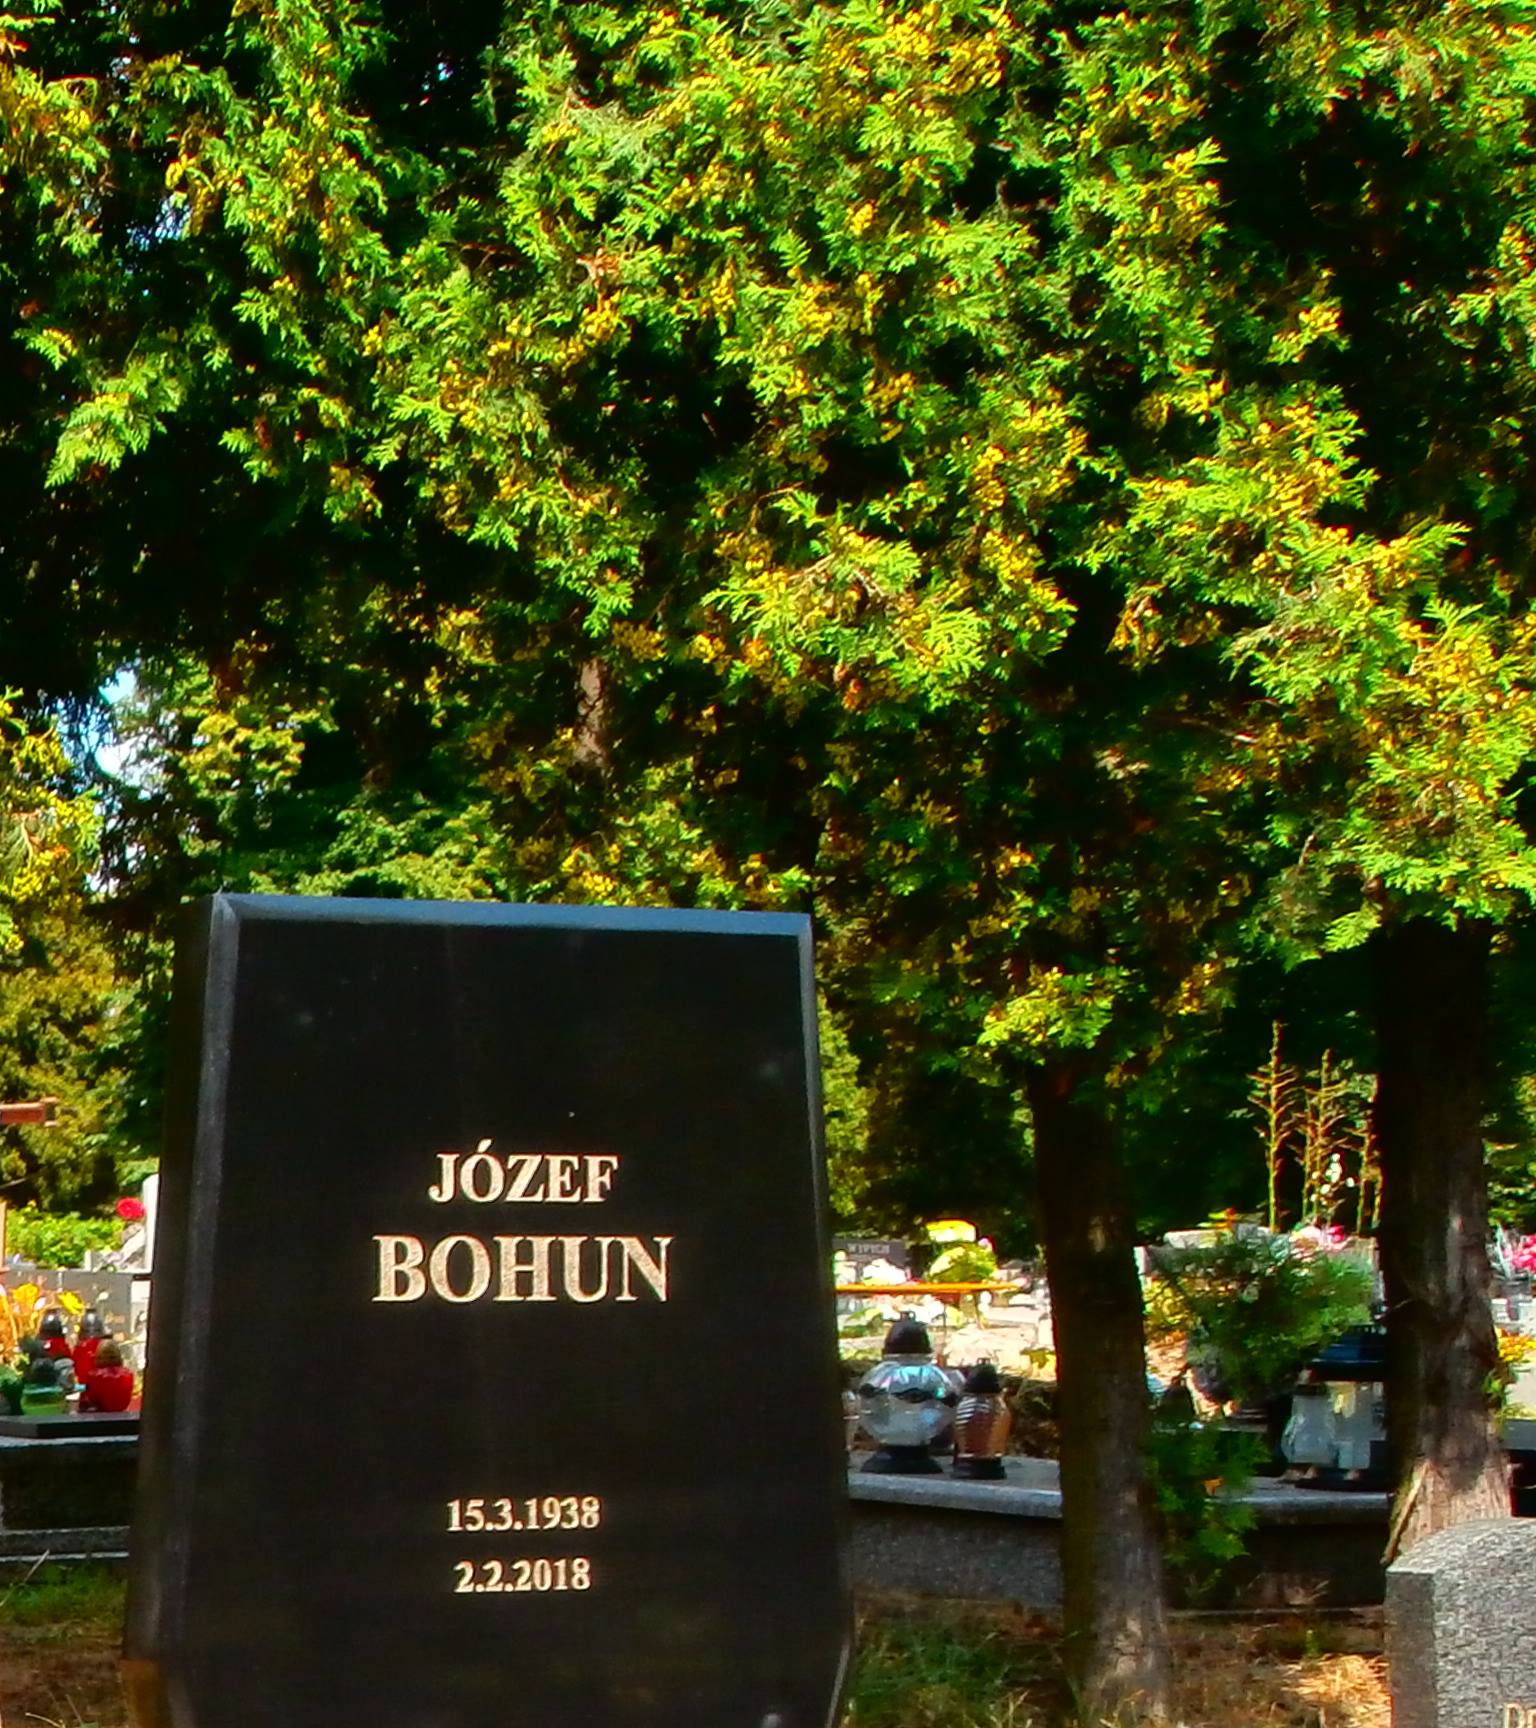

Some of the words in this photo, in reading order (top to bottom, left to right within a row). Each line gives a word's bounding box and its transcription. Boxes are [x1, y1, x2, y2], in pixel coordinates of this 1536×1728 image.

[428, 1138, 619, 1203] JÓZEF
[371, 1234, 674, 1303] BOHUN
[447, 1495, 600, 1532] 15.3.1938
[454, 1557, 591, 1593] 2.2.2018
